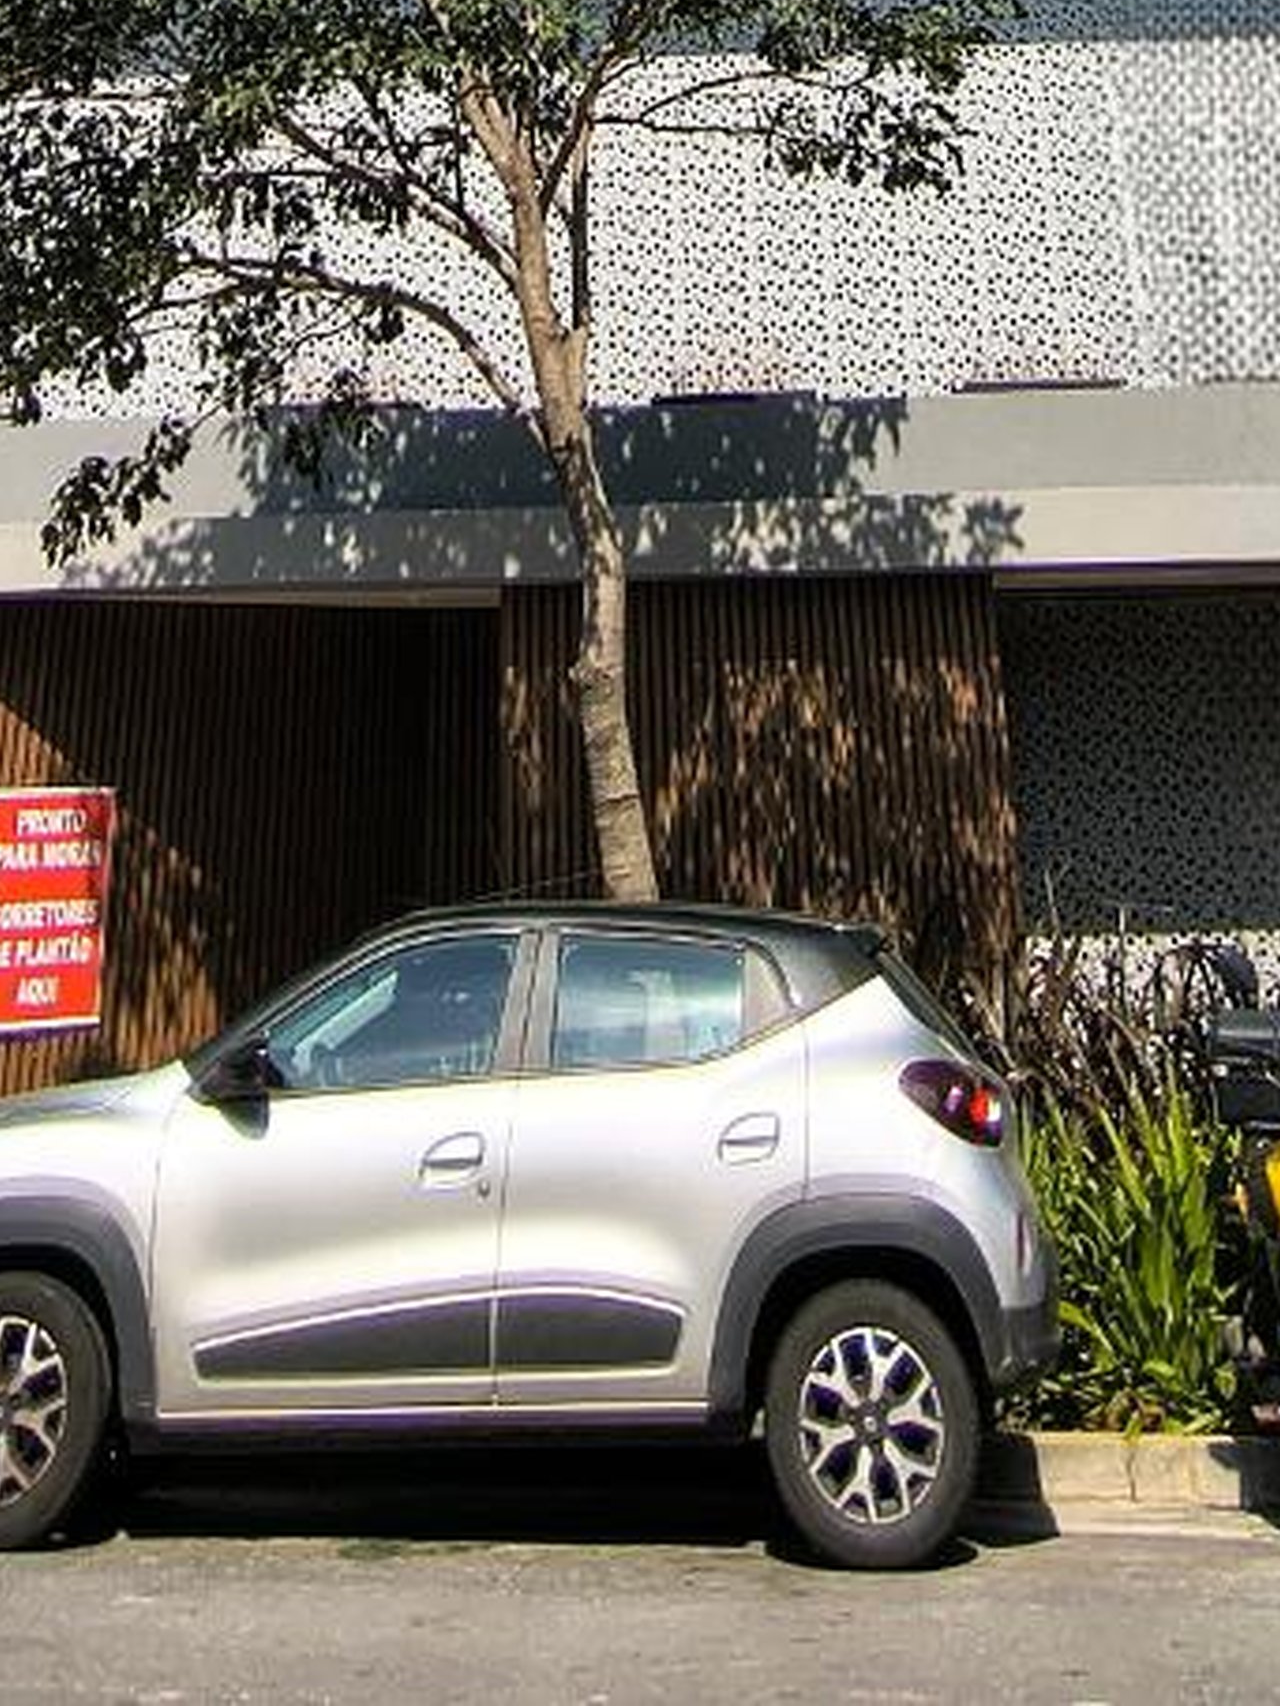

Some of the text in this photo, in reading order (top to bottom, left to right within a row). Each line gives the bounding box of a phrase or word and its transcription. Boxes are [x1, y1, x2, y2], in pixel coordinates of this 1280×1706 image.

[17, 808, 88, 837] PRONTO
[41, 839, 101, 868] MORAR
[15, 929, 94, 967] PLANTÃO
[16, 974, 61, 1005] AQUI
